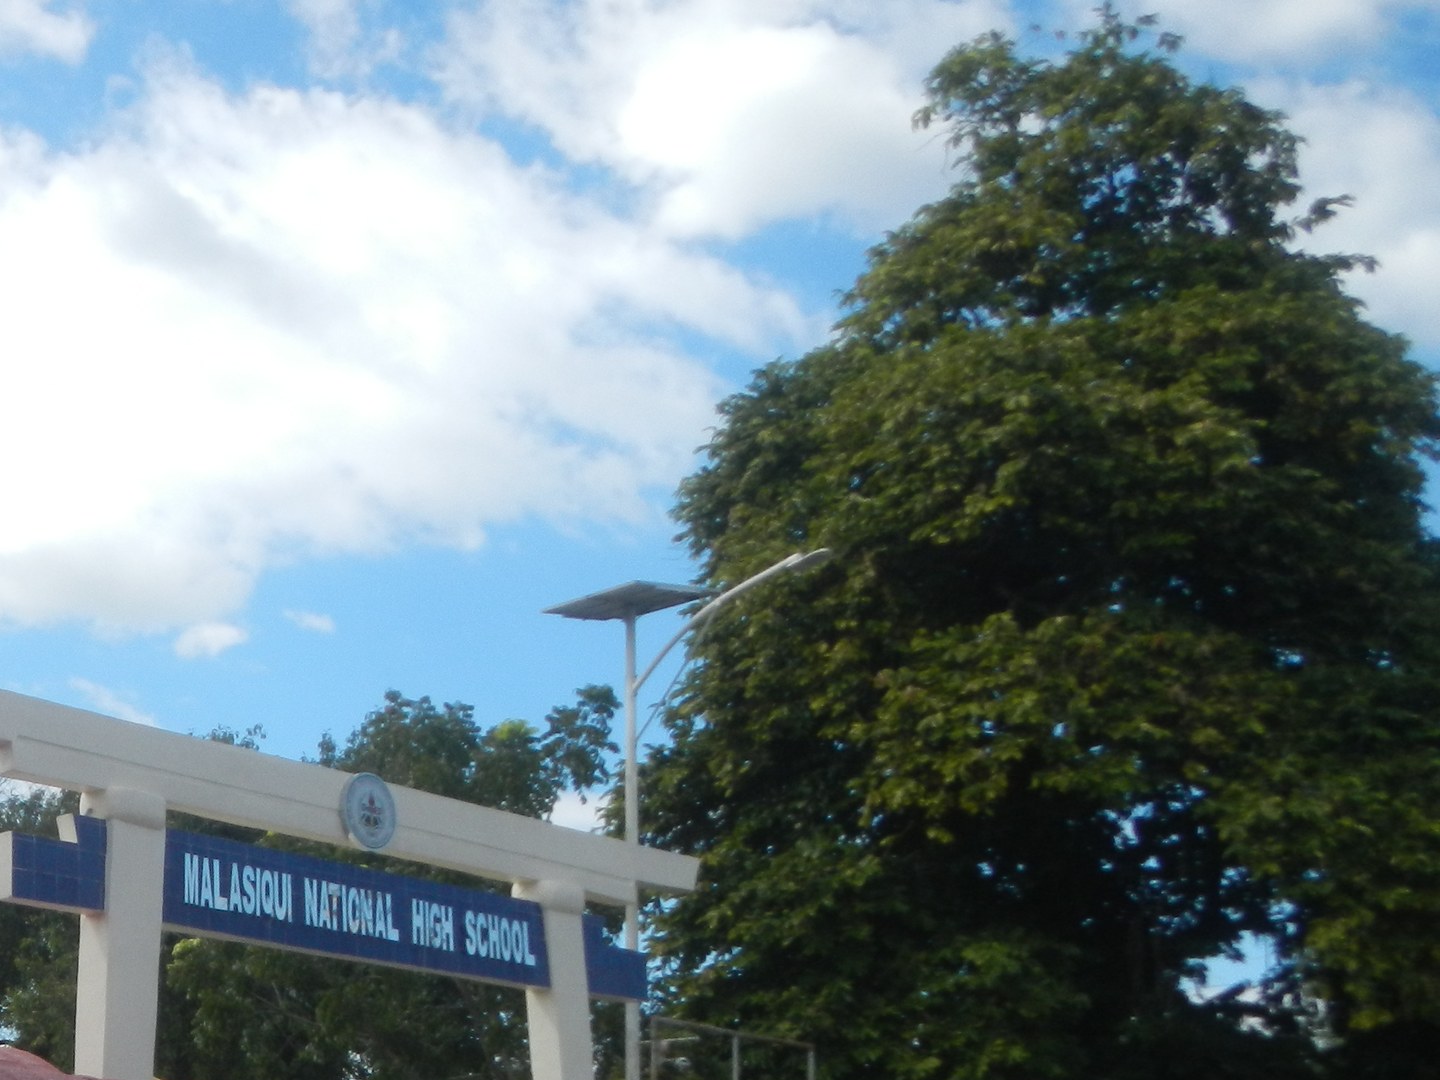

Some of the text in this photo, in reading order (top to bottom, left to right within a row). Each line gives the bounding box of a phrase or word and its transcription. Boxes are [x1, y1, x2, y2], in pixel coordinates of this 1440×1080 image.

[184, 852, 536, 967] MALASIQUI NATIONAL HIGH SCHOOL
